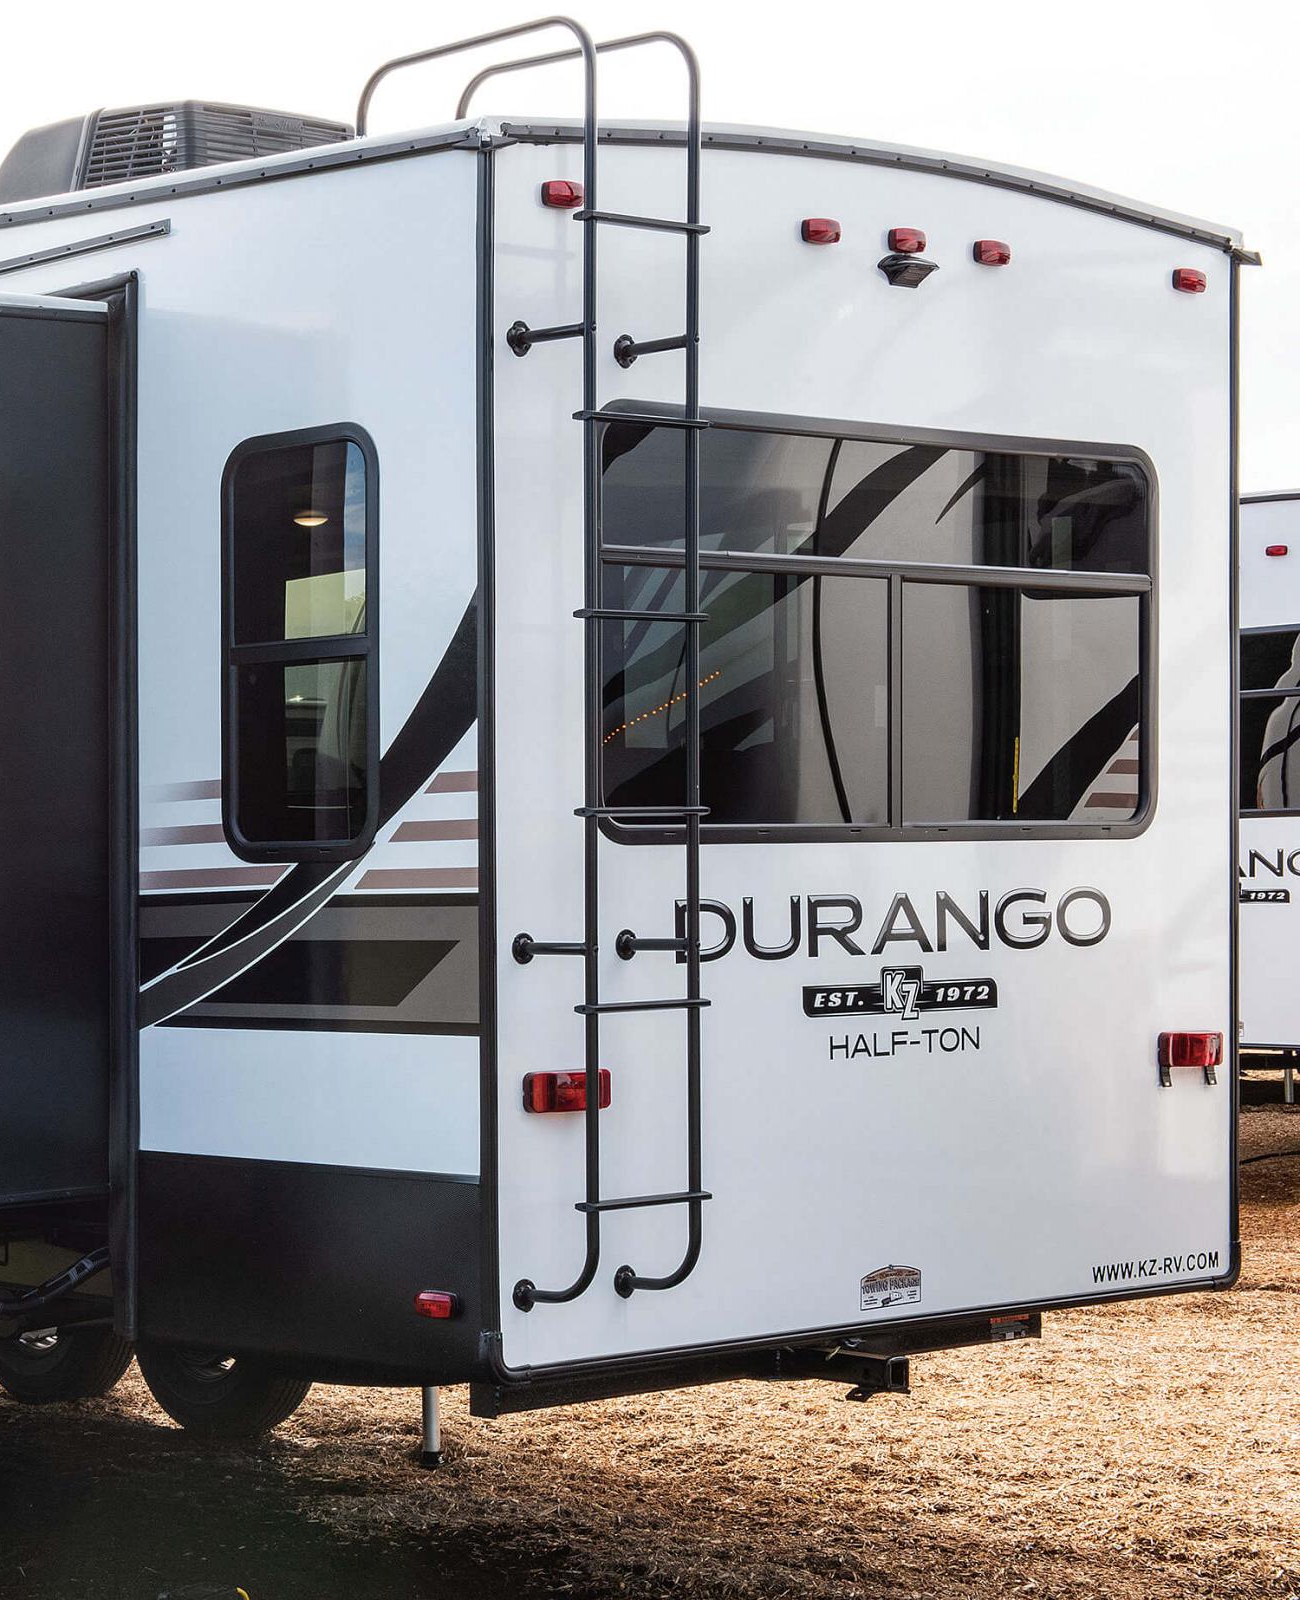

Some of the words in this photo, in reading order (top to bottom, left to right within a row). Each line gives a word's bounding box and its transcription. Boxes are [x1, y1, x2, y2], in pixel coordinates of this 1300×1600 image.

[1250, 891, 1286, 900] 1972
[674, 885, 1112, 965] DURANGO
[813, 991, 864, 1008] EST.
[935, 985, 990, 1002] 1972
[829, 1026, 981, 1060] HALF-TON
[1092, 1251, 1219, 1283] WWW.KZ-RV.COM
